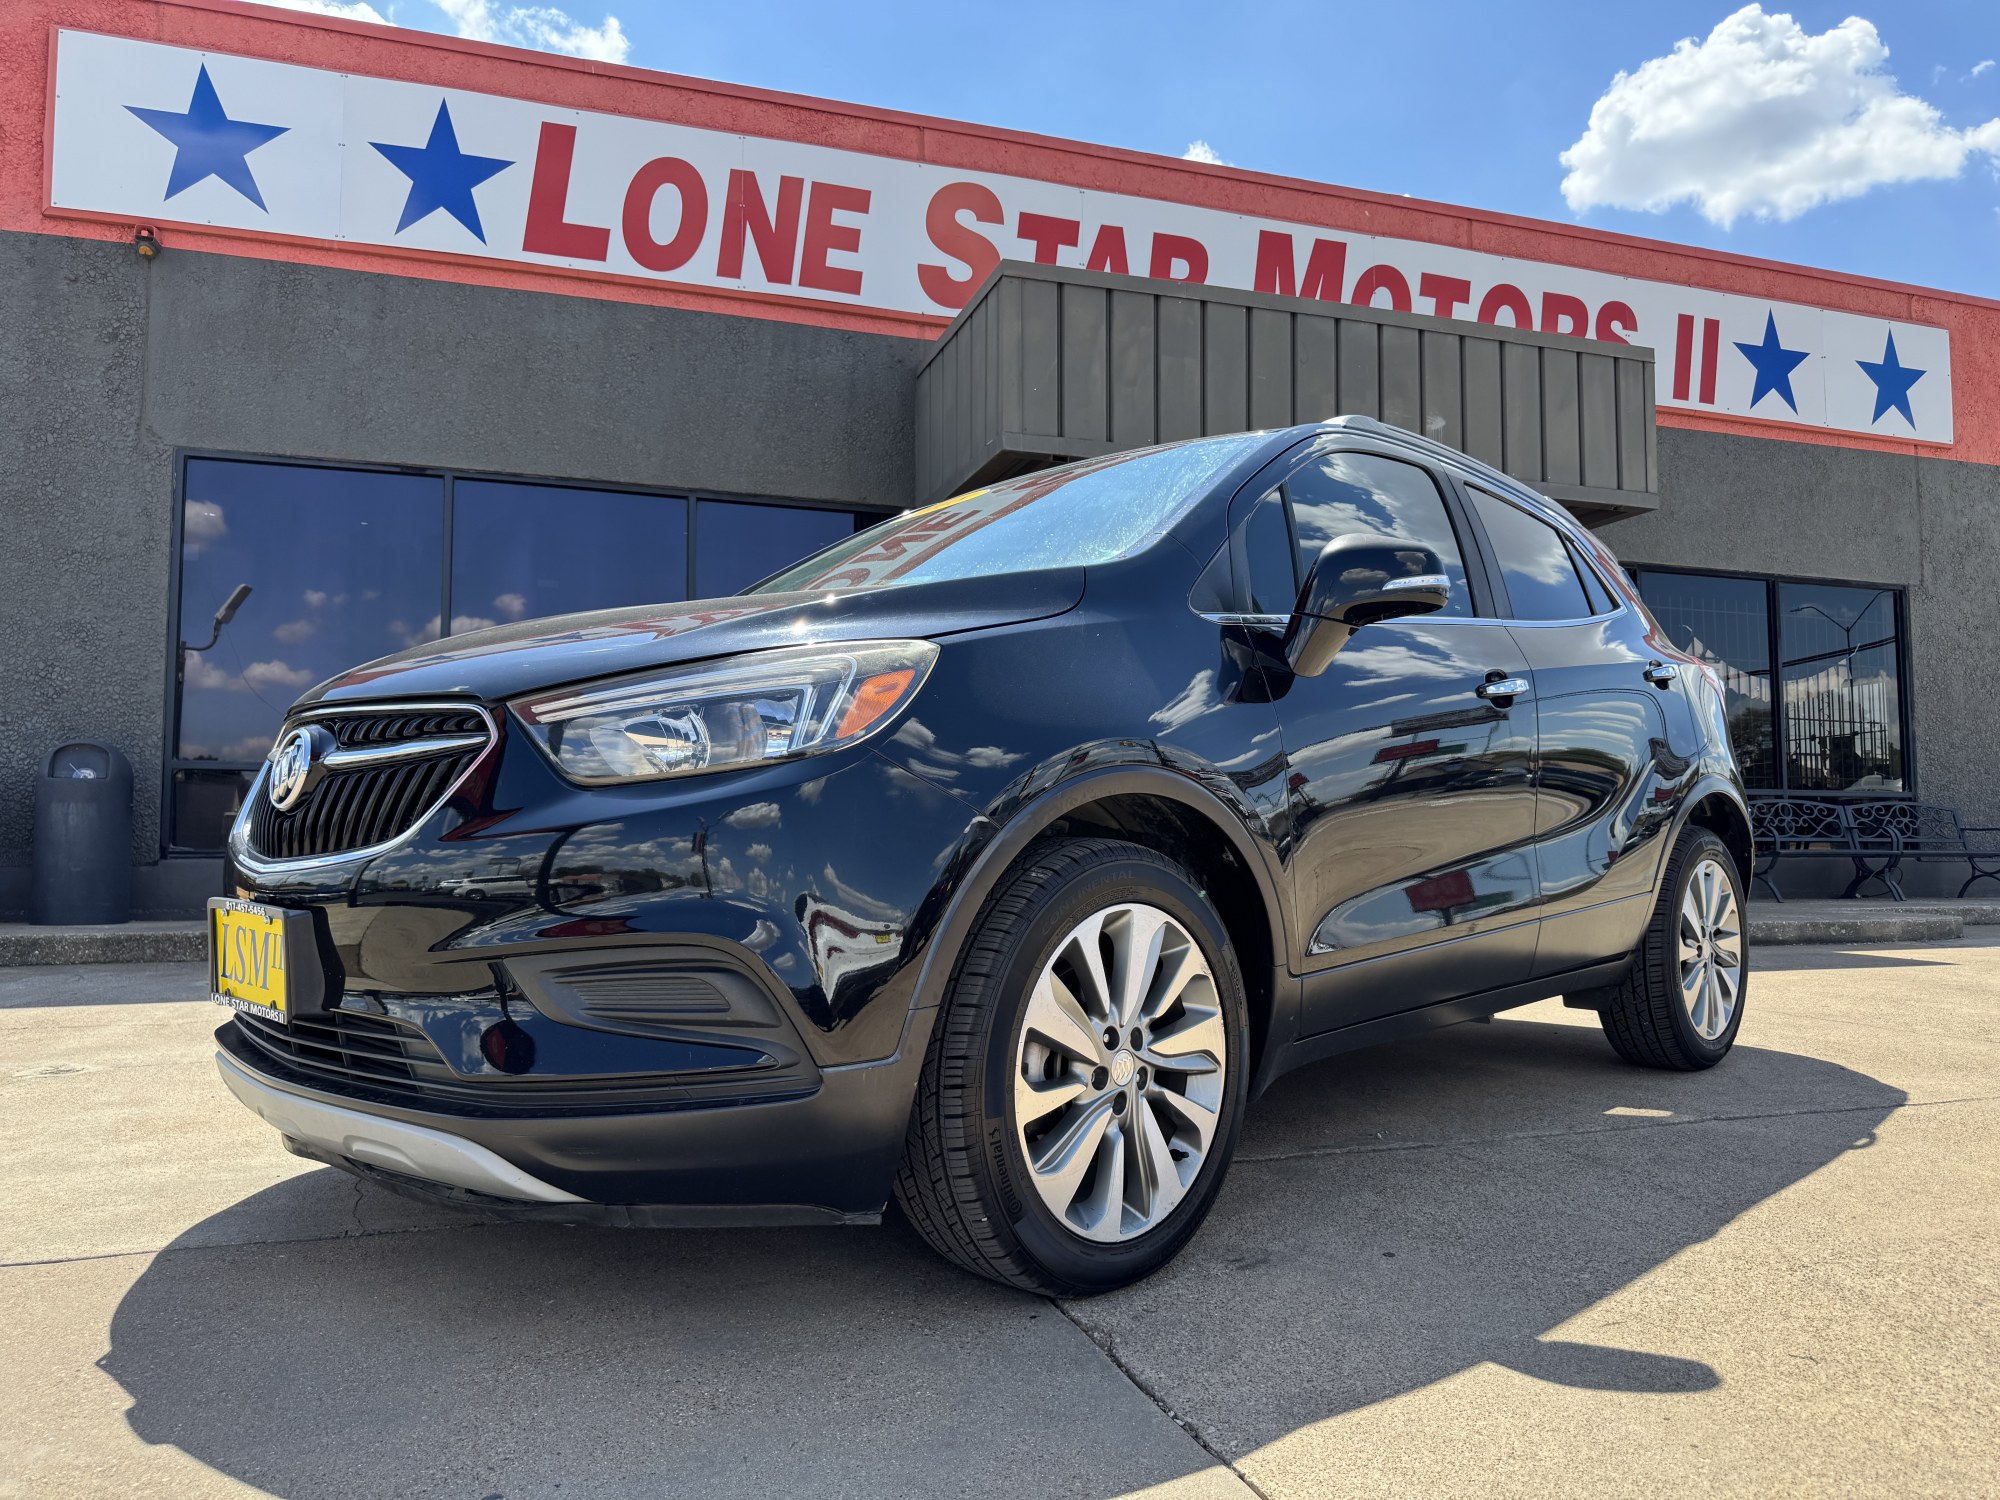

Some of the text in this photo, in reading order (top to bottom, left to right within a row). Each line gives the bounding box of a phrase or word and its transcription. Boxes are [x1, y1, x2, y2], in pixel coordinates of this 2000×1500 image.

[522, 121, 872, 296] LONE
[1672, 314, 1720, 405] II
[211, 993, 230, 1006] LONE
[231, 998, 249, 1013] STAR
[250, 1003, 279, 1021] MOTORS
